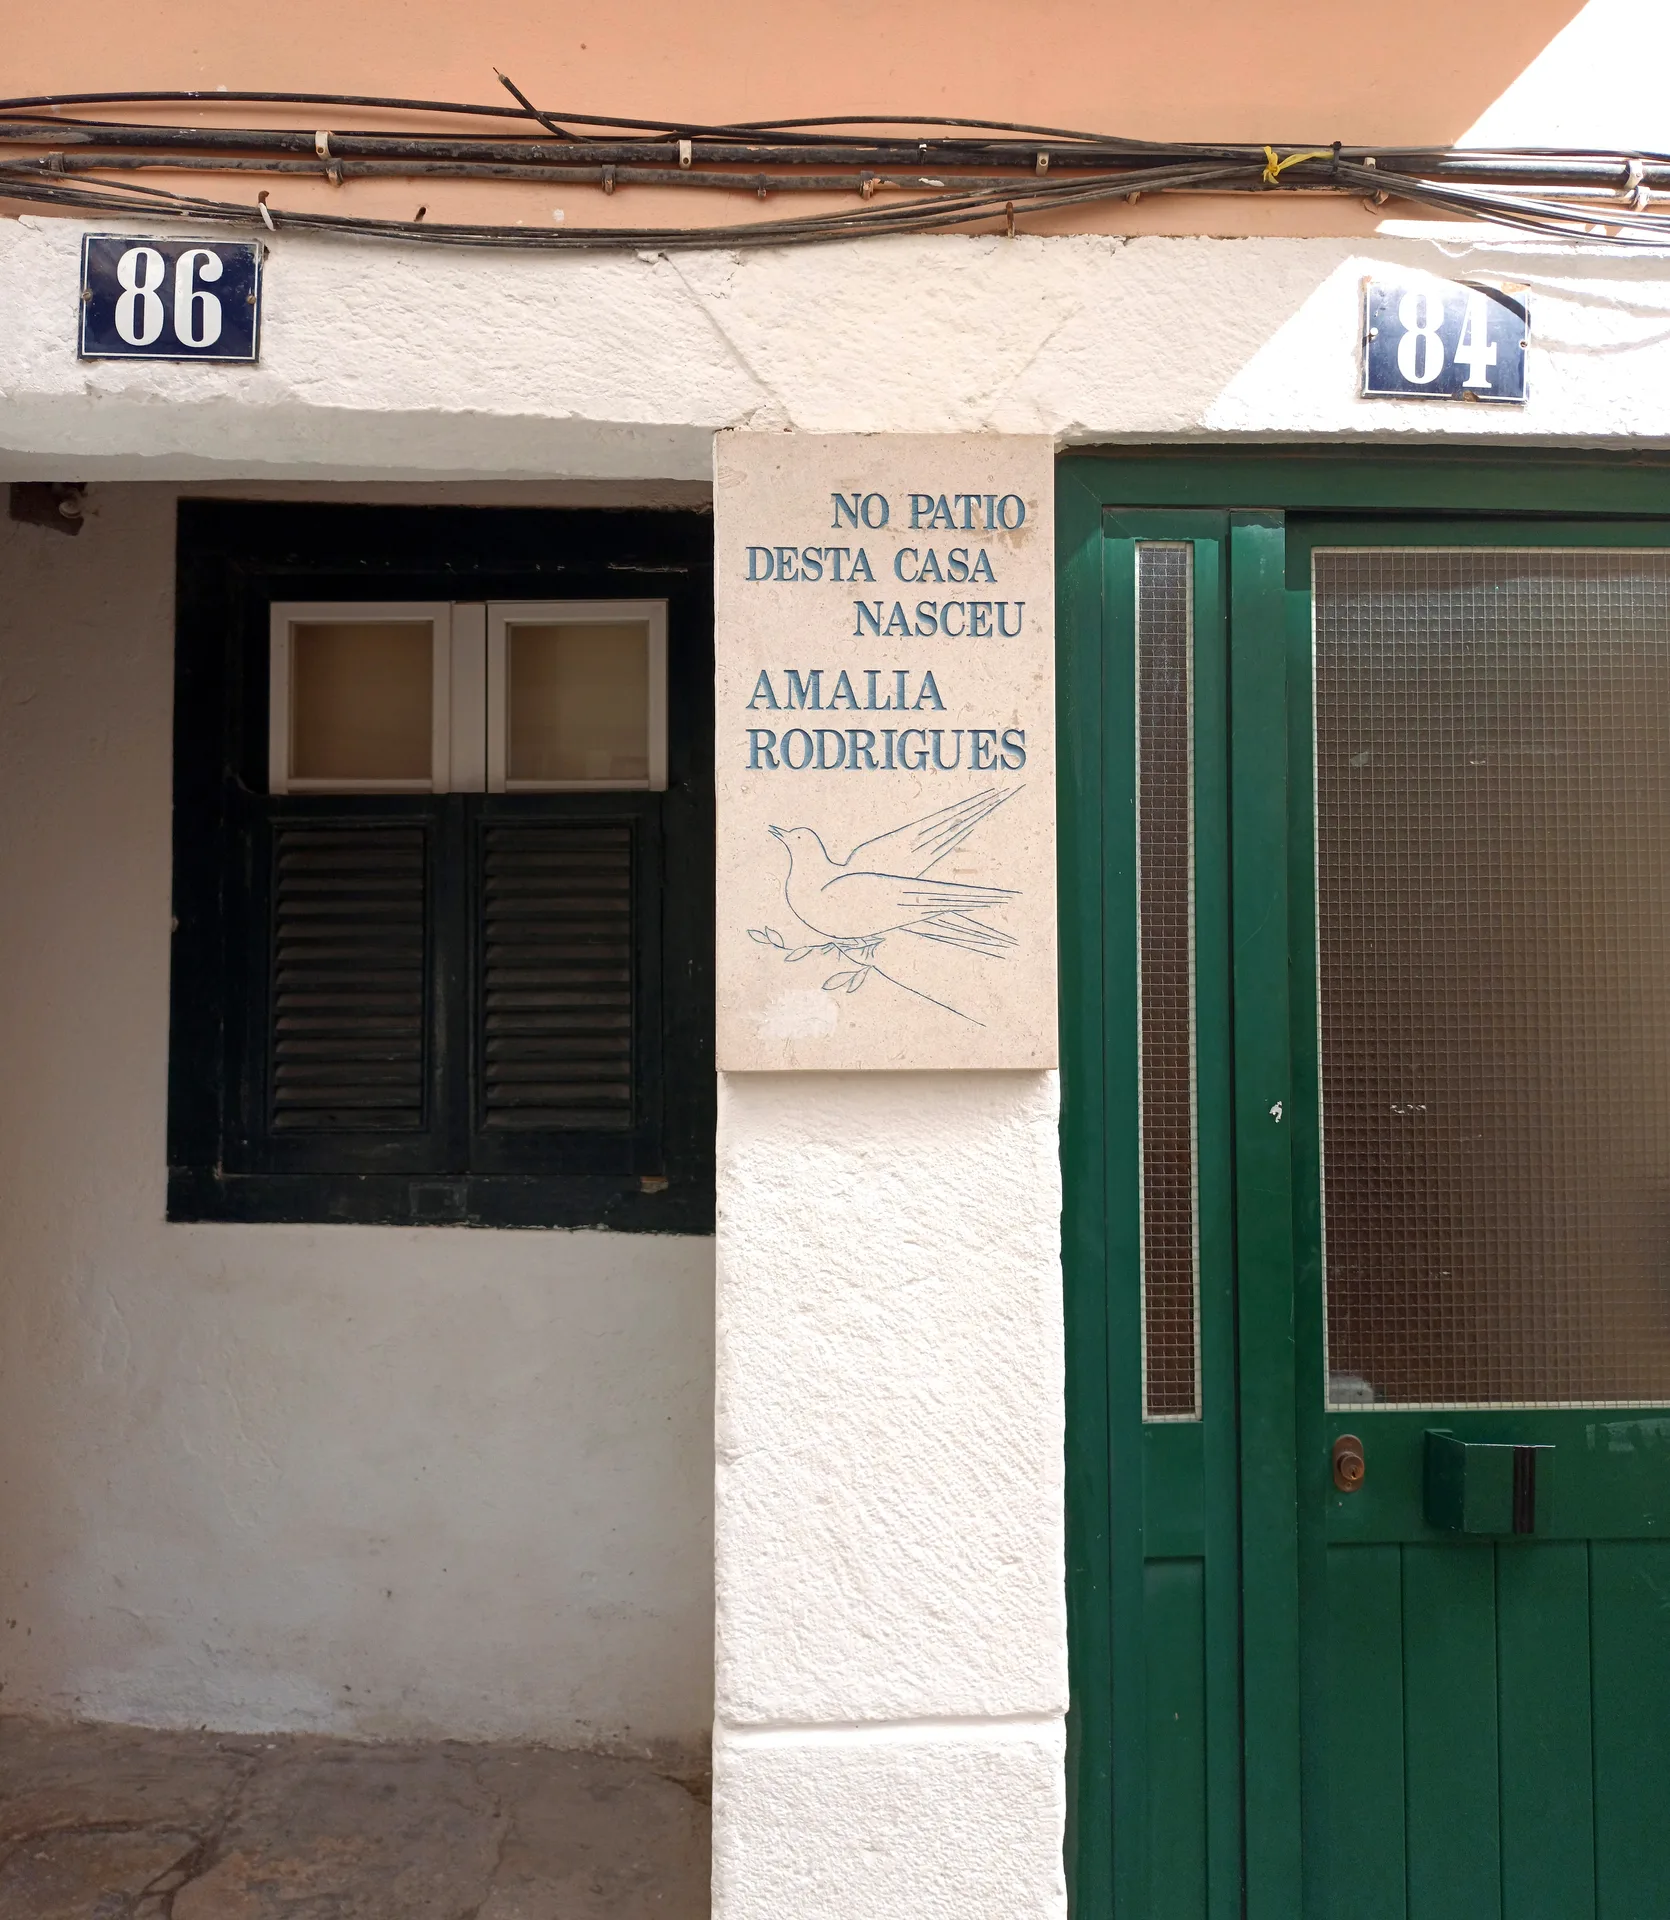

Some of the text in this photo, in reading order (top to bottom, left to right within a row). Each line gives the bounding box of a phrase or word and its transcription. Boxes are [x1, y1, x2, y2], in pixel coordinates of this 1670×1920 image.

[115, 247, 223, 347] 86
[1397, 284, 1497, 388] 84
[831, 493, 1026, 530] NO PATIO
[745, 547, 997, 583] DESTA CASA
[853, 601, 1025, 638] NASCEU
[745, 669, 947, 710] AMALIA
[745, 728, 1026, 771] RODRIGUES
